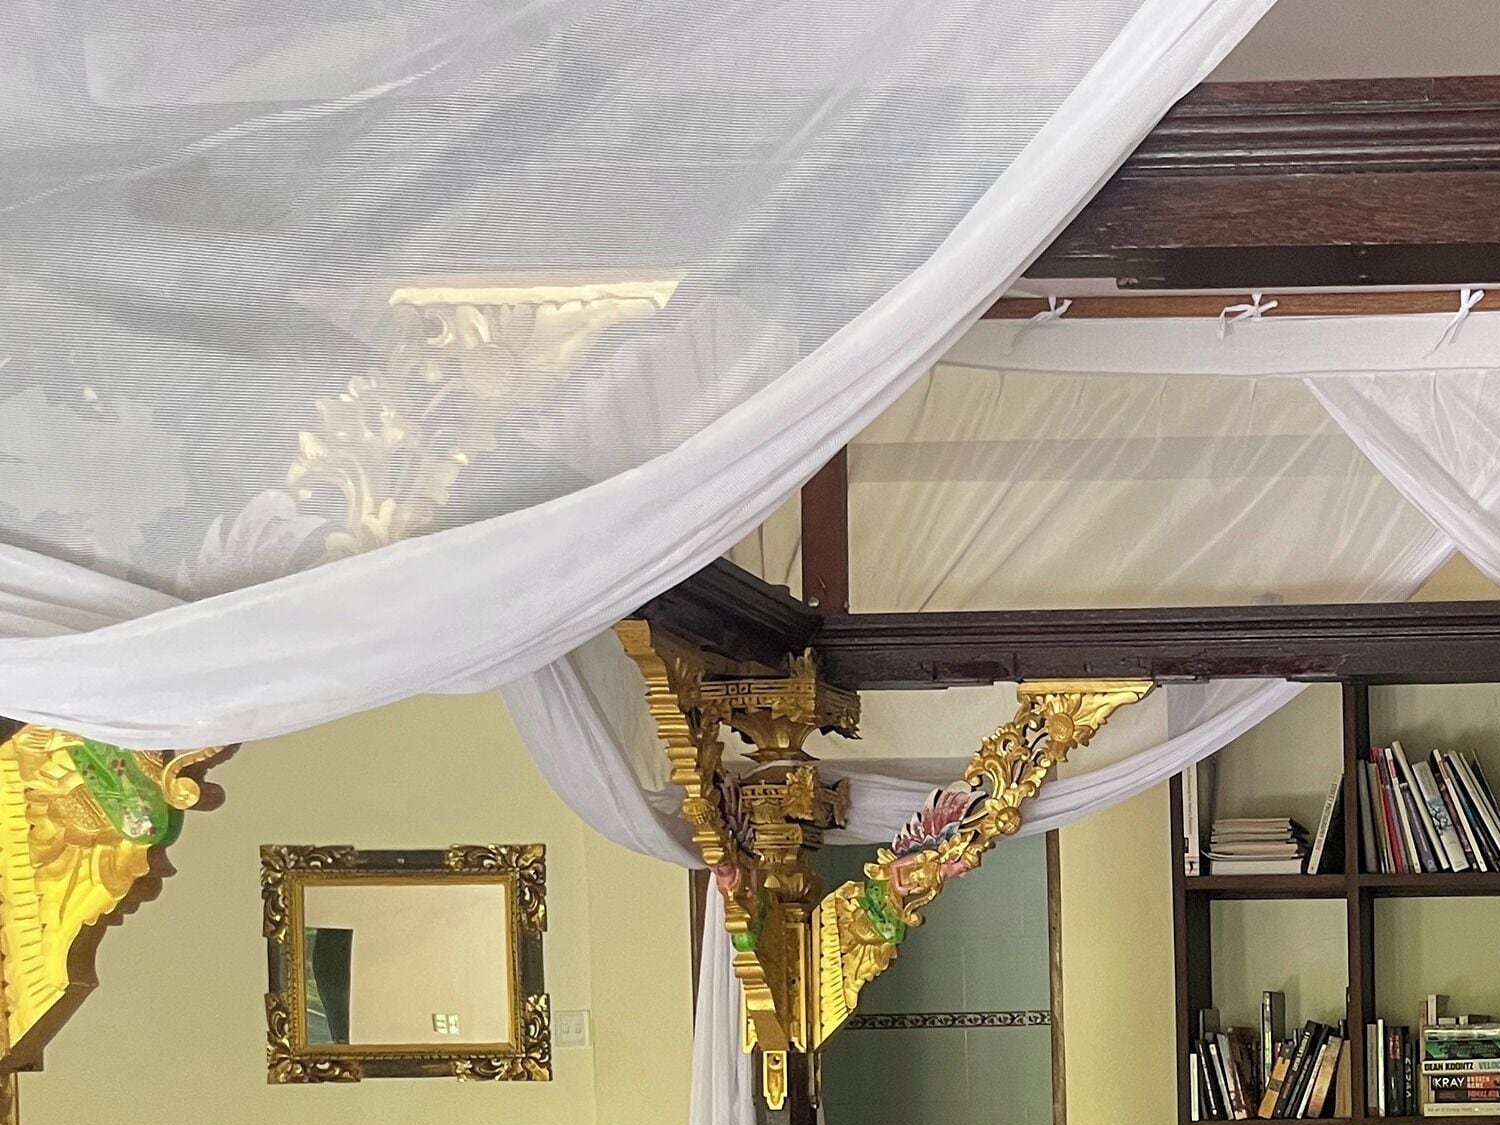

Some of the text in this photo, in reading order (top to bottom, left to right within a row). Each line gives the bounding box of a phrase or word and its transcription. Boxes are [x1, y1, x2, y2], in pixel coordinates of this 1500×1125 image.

[1424, 1063, 1443, 1071] DEAN
[1445, 1062, 1473, 1070] KOONTZ
[1435, 1077, 1465, 1088] KRAY
